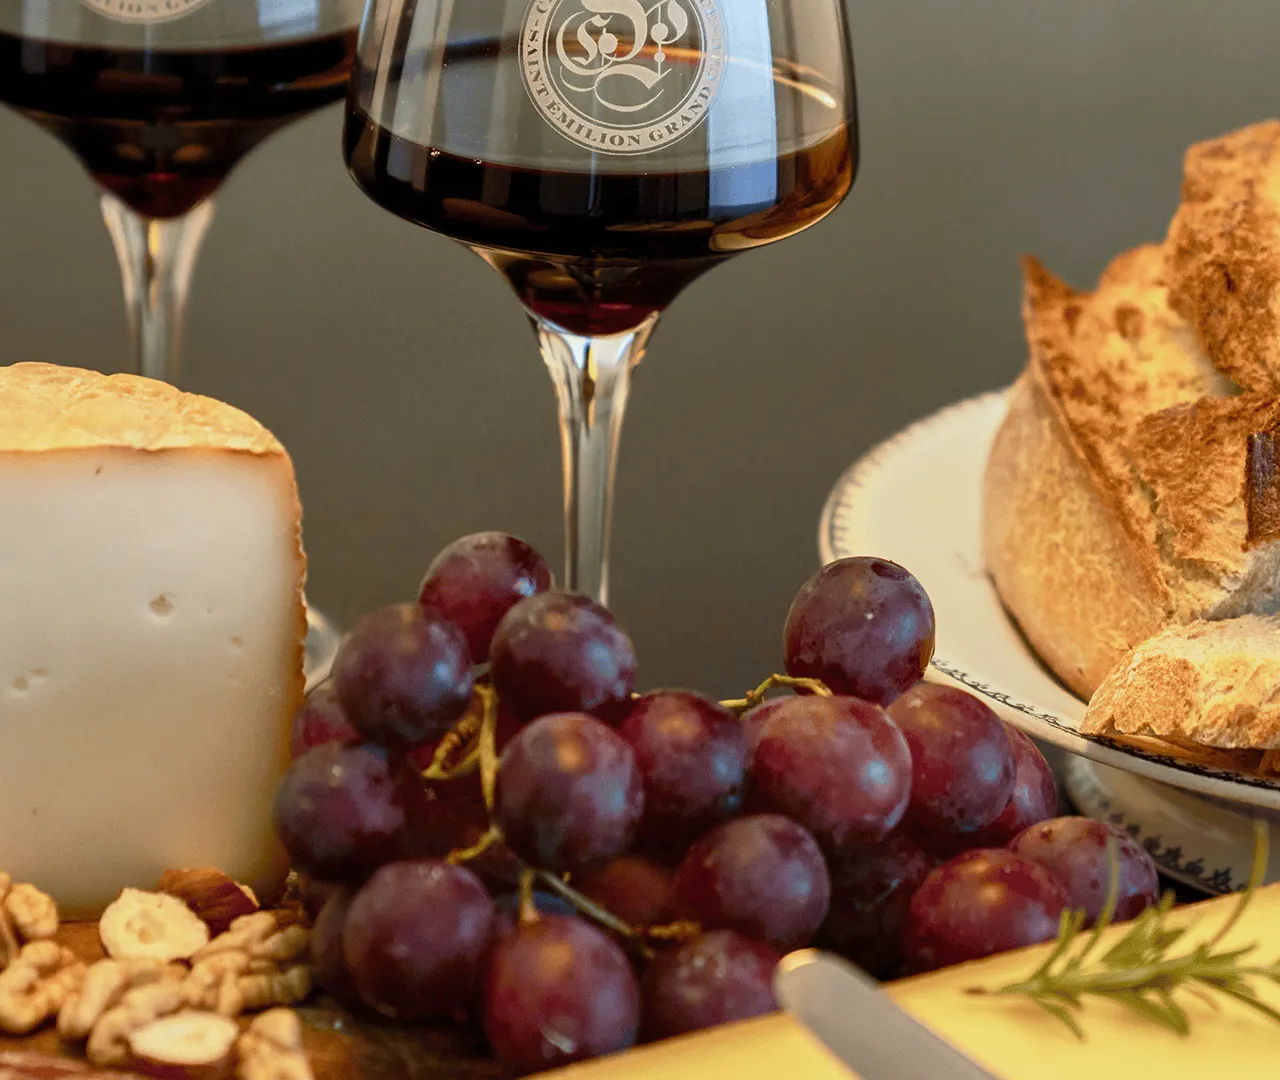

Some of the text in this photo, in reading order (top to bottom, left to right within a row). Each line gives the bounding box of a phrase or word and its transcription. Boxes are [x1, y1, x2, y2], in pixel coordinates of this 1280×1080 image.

[526, 33, 549, 98] SAINT
[546, 99, 641, 146] ÉMILION
[648, 85, 712, 142] GRAND
